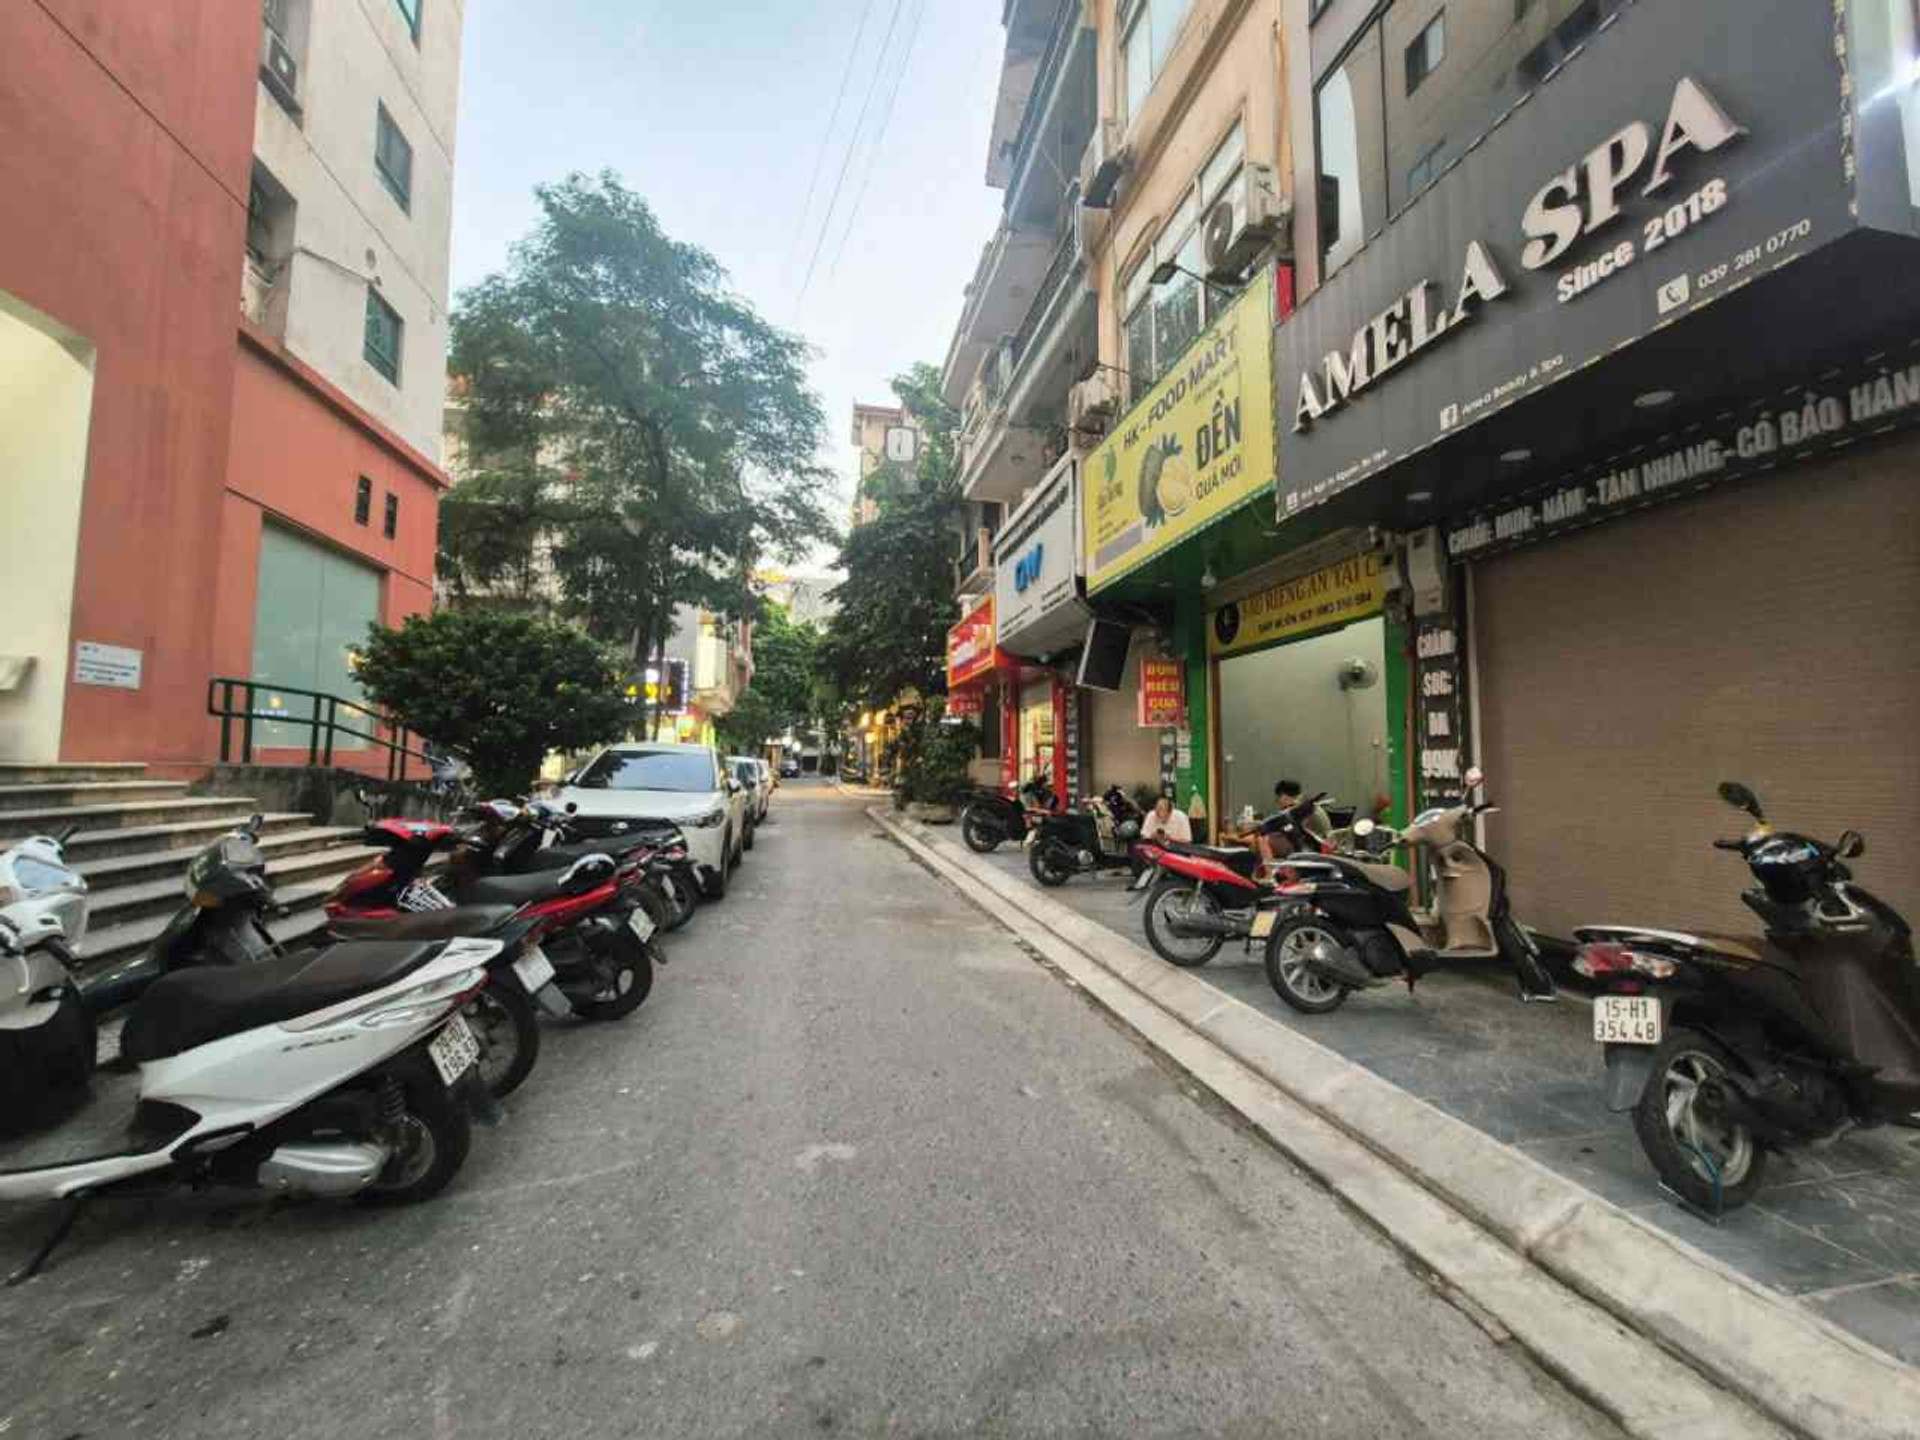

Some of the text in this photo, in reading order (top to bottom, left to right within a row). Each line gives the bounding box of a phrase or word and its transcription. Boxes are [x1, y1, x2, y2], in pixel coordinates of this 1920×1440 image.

[1293, 76, 1747, 432] AMELA SPA
[1557, 178, 1728, 302] Since 2018
[1698, 218, 1811, 289] 039 281 0770
[1147, 380, 1186, 430] FOOD
[1188, 332, 1238, 390] MART
[1605, 1000, 1648, 1019] 15-H1
